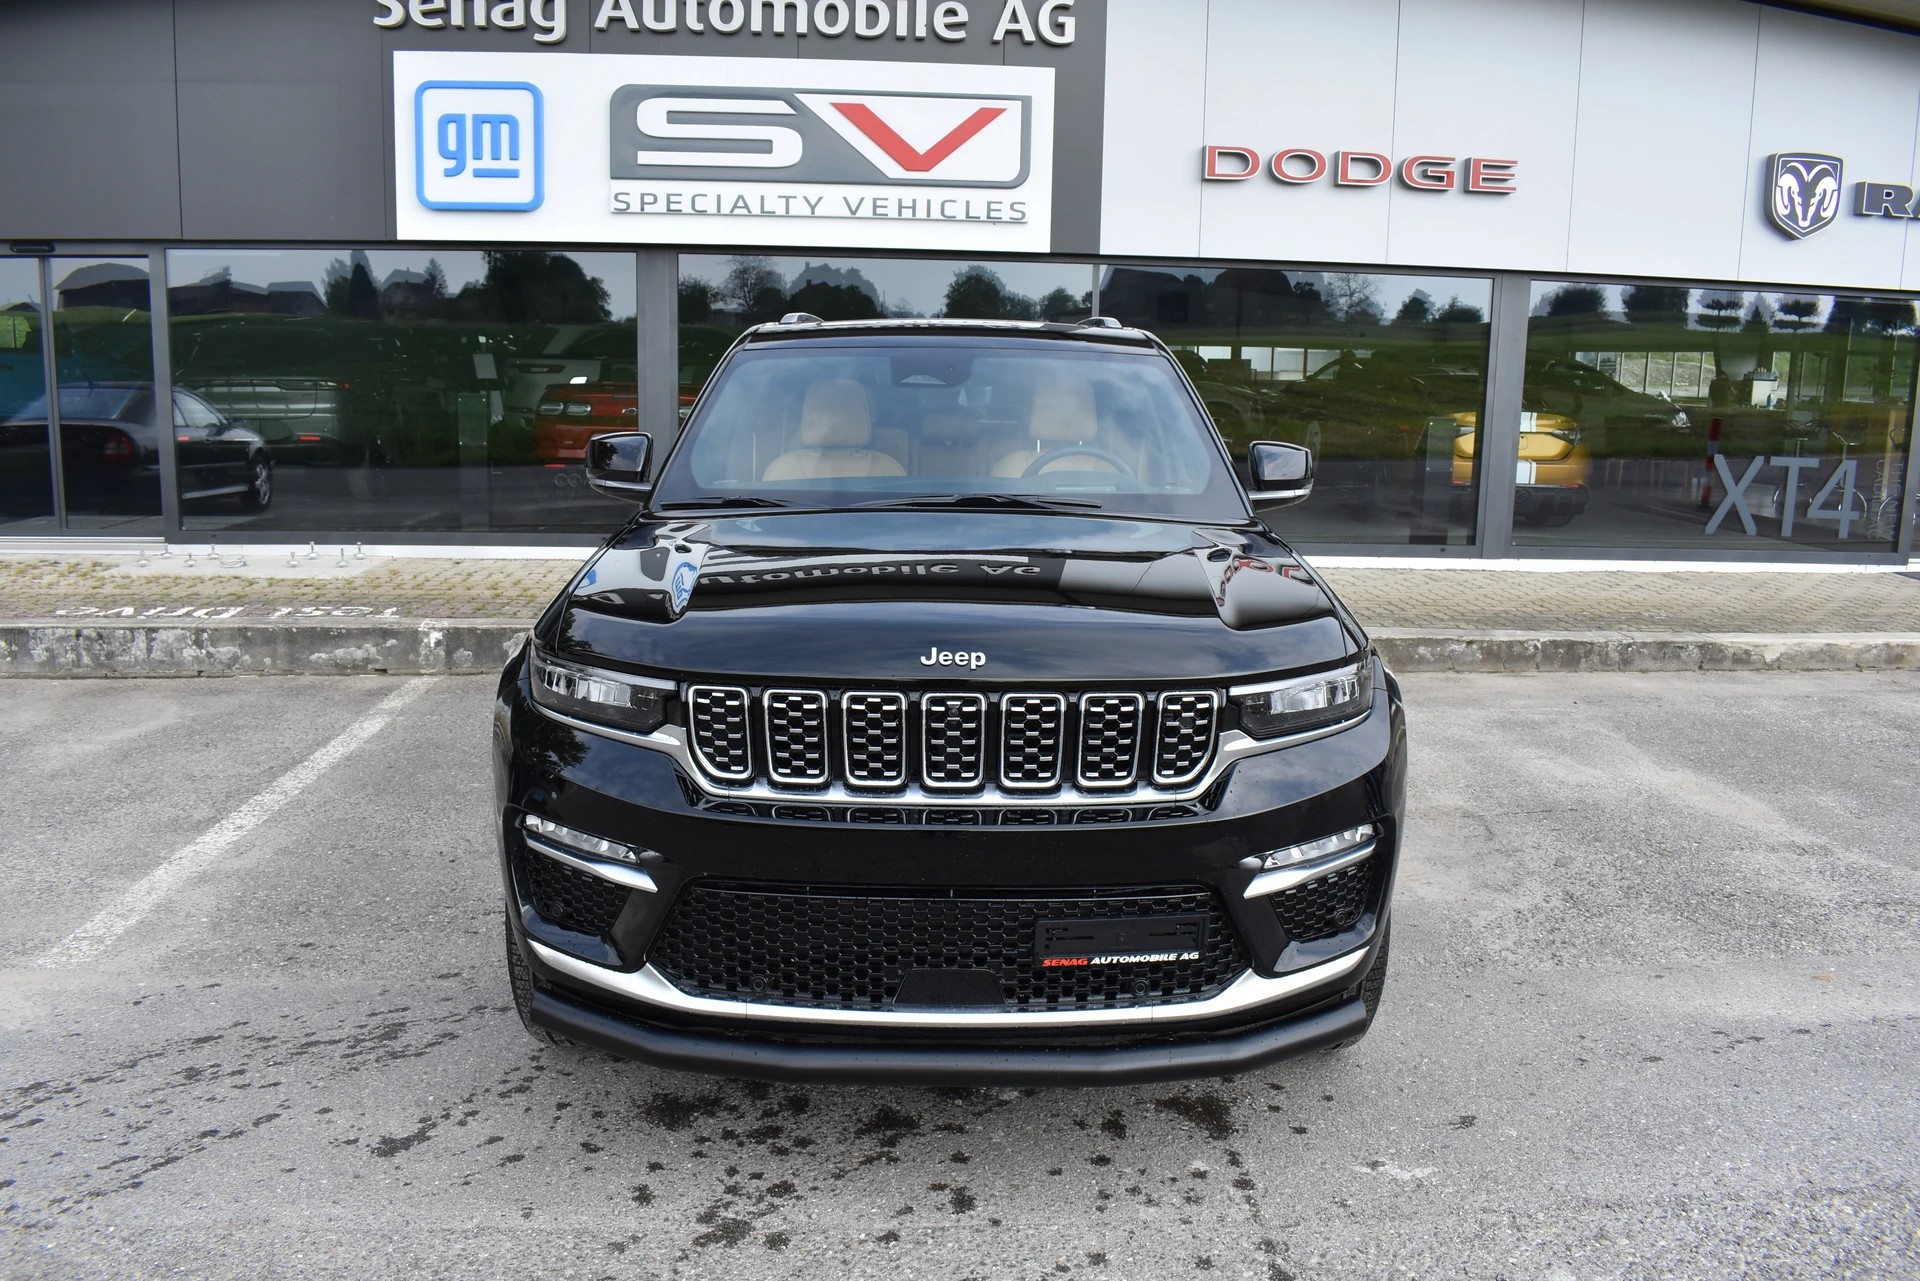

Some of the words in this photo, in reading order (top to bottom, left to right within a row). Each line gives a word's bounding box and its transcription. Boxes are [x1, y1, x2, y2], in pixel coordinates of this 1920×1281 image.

[373, 0, 567, 44] Senag
[594, 0, 969, 41] Automobile
[991, 0, 1076, 45] AG
[438, 113, 520, 178] gm
[1201, 144, 1518, 194] DODGE
[612, 192, 824, 216] SPECIALTY
[842, 196, 1028, 221] VEHICLES
[1854, 181, 1920, 218] R
[1704, 453, 1861, 540] XT4
[1889, 459, 1905, 495] THE
[1866, 459, 1886, 541] CADILLAC
[1881, 500, 1900, 542] NEW
[920, 646, 987, 671] Jeep
[1042, 957, 1089, 967] SENAG
[1090, 953, 1178, 965] AUTOMOBILE
[1179, 951, 1200, 960] AG
